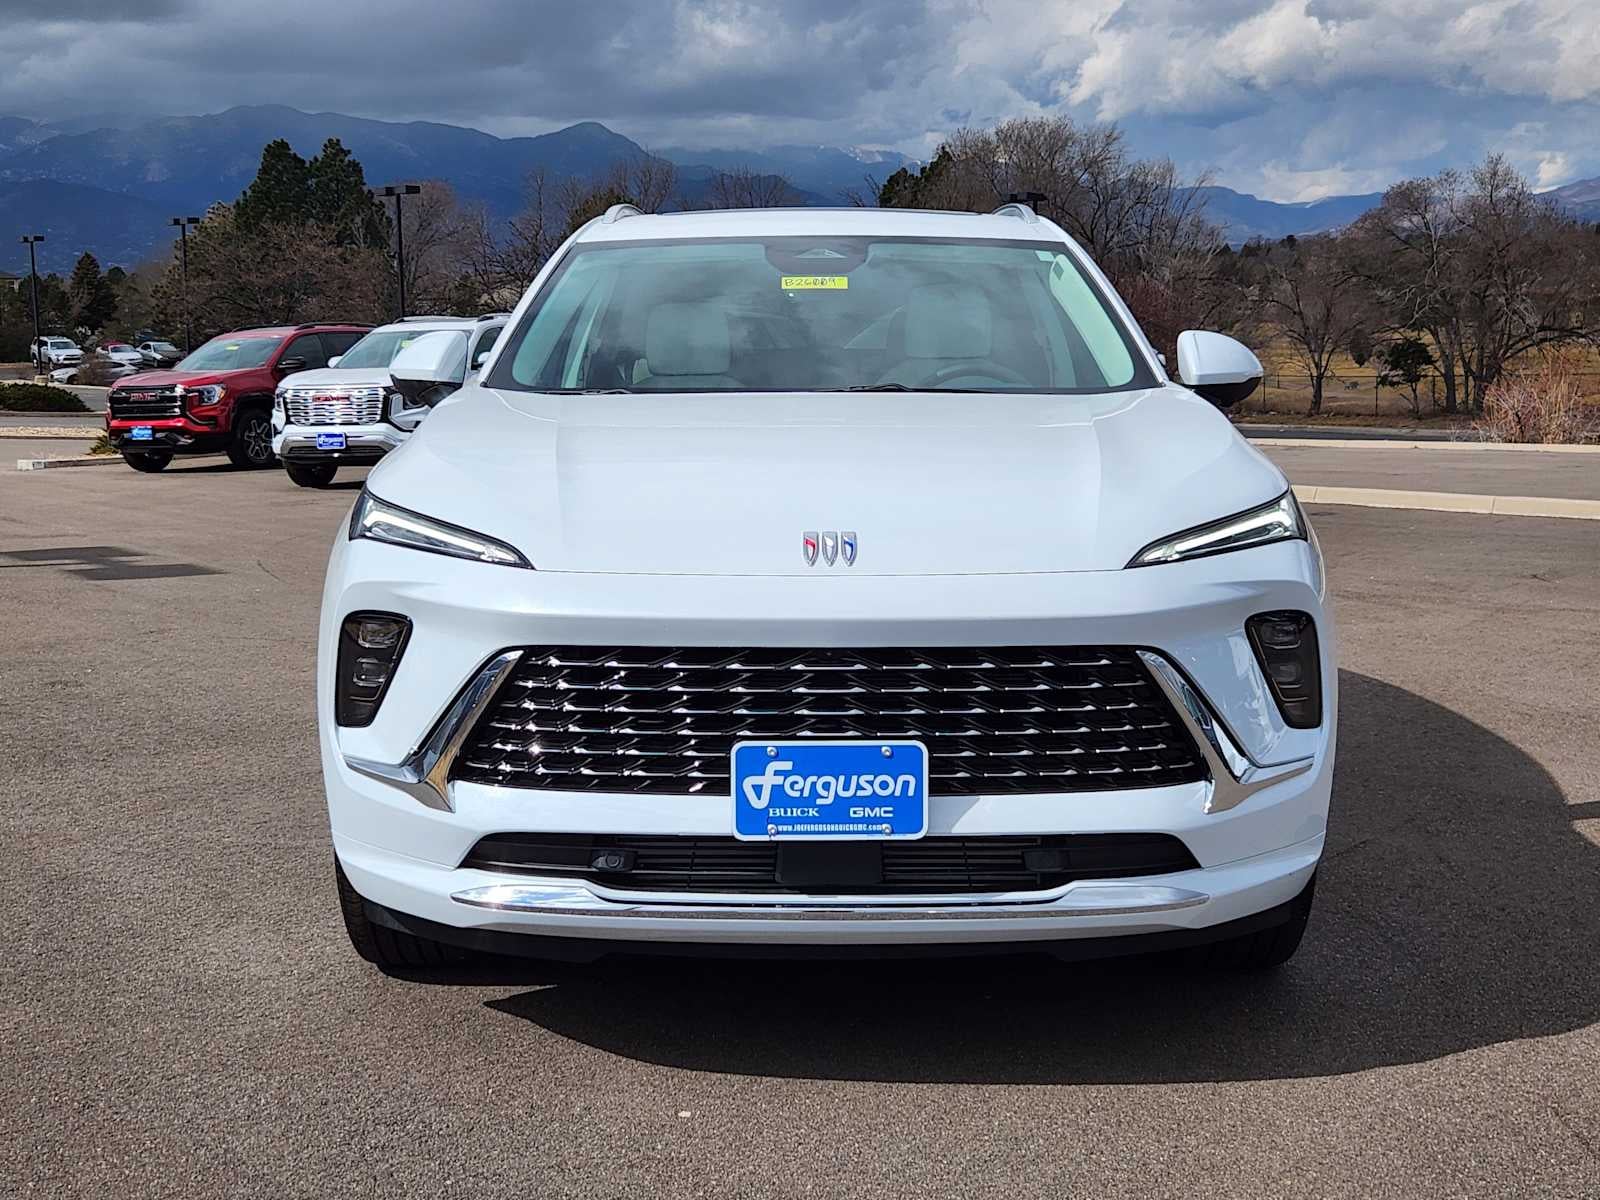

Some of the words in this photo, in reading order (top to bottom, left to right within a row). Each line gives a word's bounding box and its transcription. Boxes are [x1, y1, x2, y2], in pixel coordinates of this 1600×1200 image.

[743, 761, 916, 809] Ferguson
[769, 807, 820, 817] BUICK
[849, 807, 894, 818] GMC
